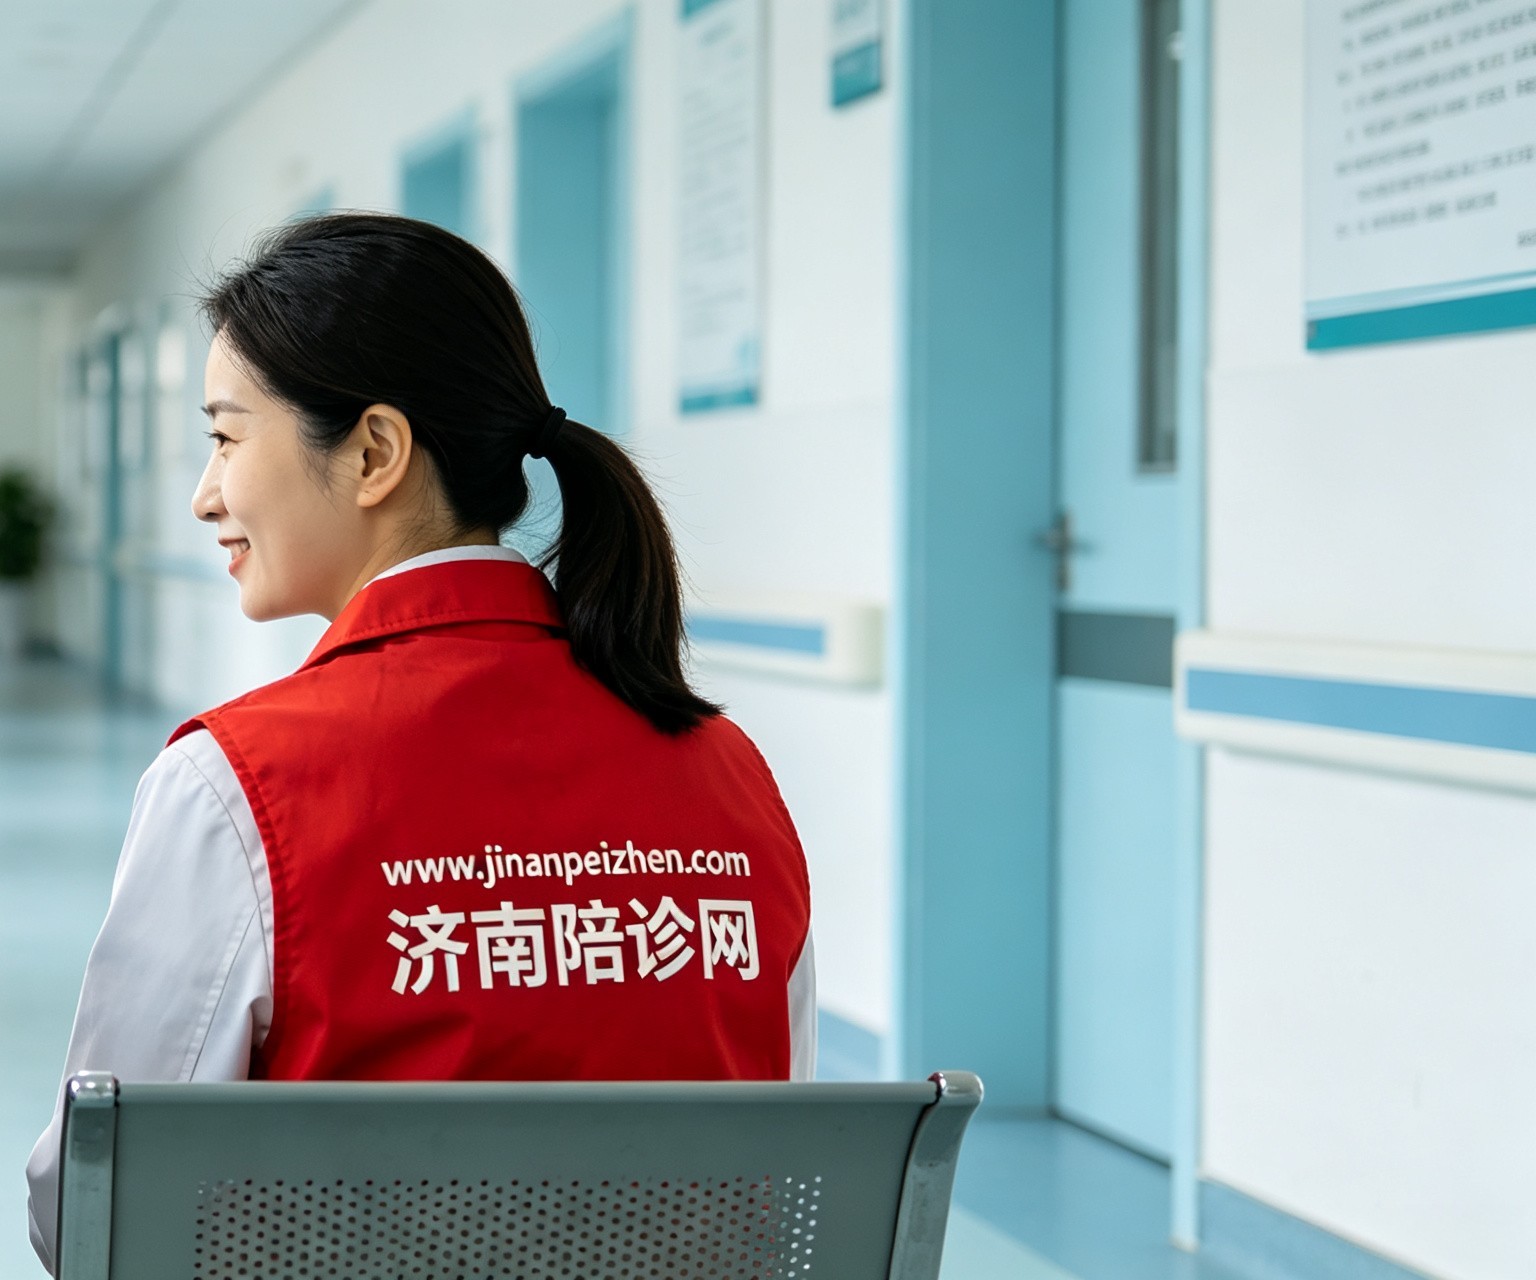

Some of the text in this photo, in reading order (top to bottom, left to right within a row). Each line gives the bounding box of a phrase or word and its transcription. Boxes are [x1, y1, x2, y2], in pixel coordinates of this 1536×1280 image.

[381, 840, 751, 889] www.jinanpeizhen.com
[386, 896, 760, 995] 济南陪诊网
